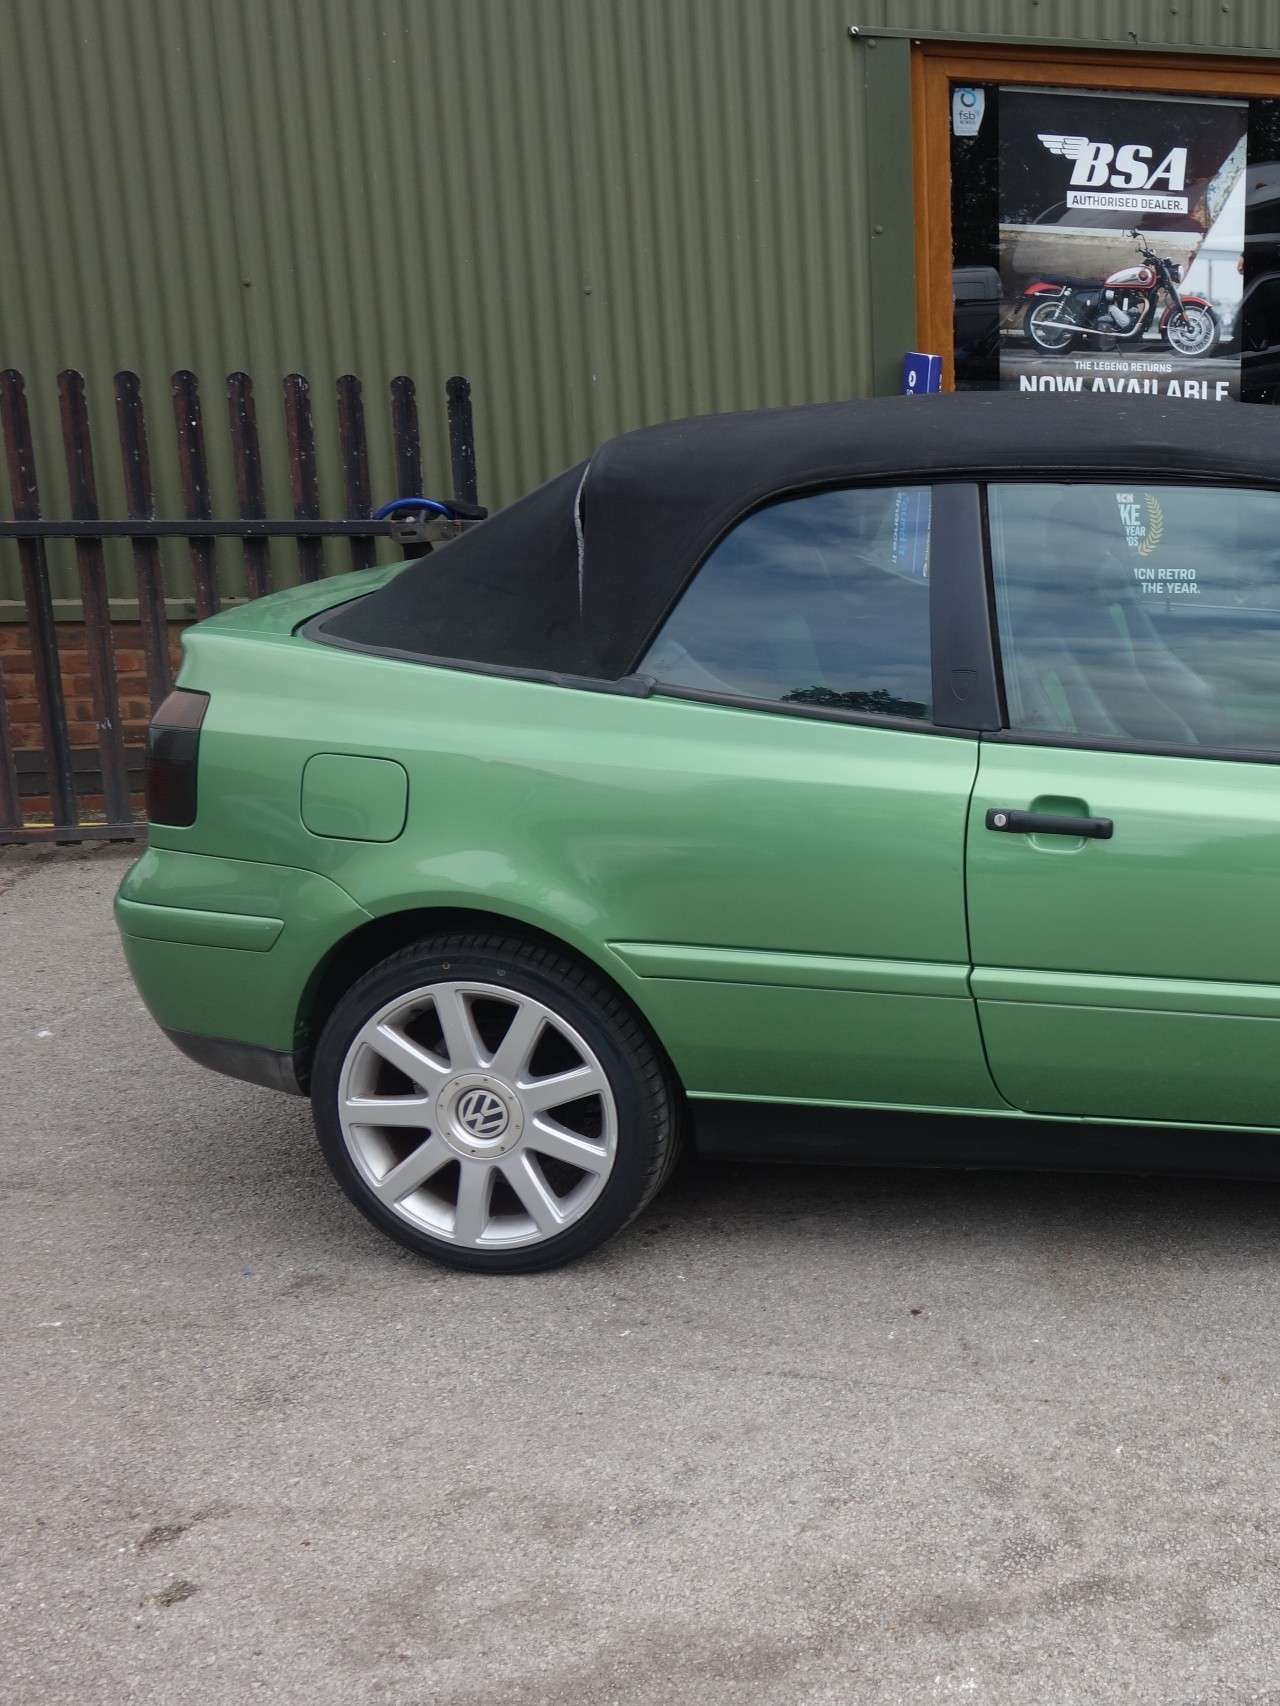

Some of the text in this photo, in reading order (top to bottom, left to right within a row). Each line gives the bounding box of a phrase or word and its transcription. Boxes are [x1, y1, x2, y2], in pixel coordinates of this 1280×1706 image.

[959, 110, 976, 120] fsb
[1069, 141, 1188, 191] BSA
[1071, 194, 1184, 211] AUTHORISED DEALER.
[1074, 360, 1173, 373] THE LEGEND RETURNS
[1019, 375, 1084, 393] NOW
[1118, 503, 1141, 526] KE
[1125, 526, 1146, 537] YEAR
[1157, 568, 1196, 580] RETRO
[1141, 582, 1201, 594] THE YEAR.
